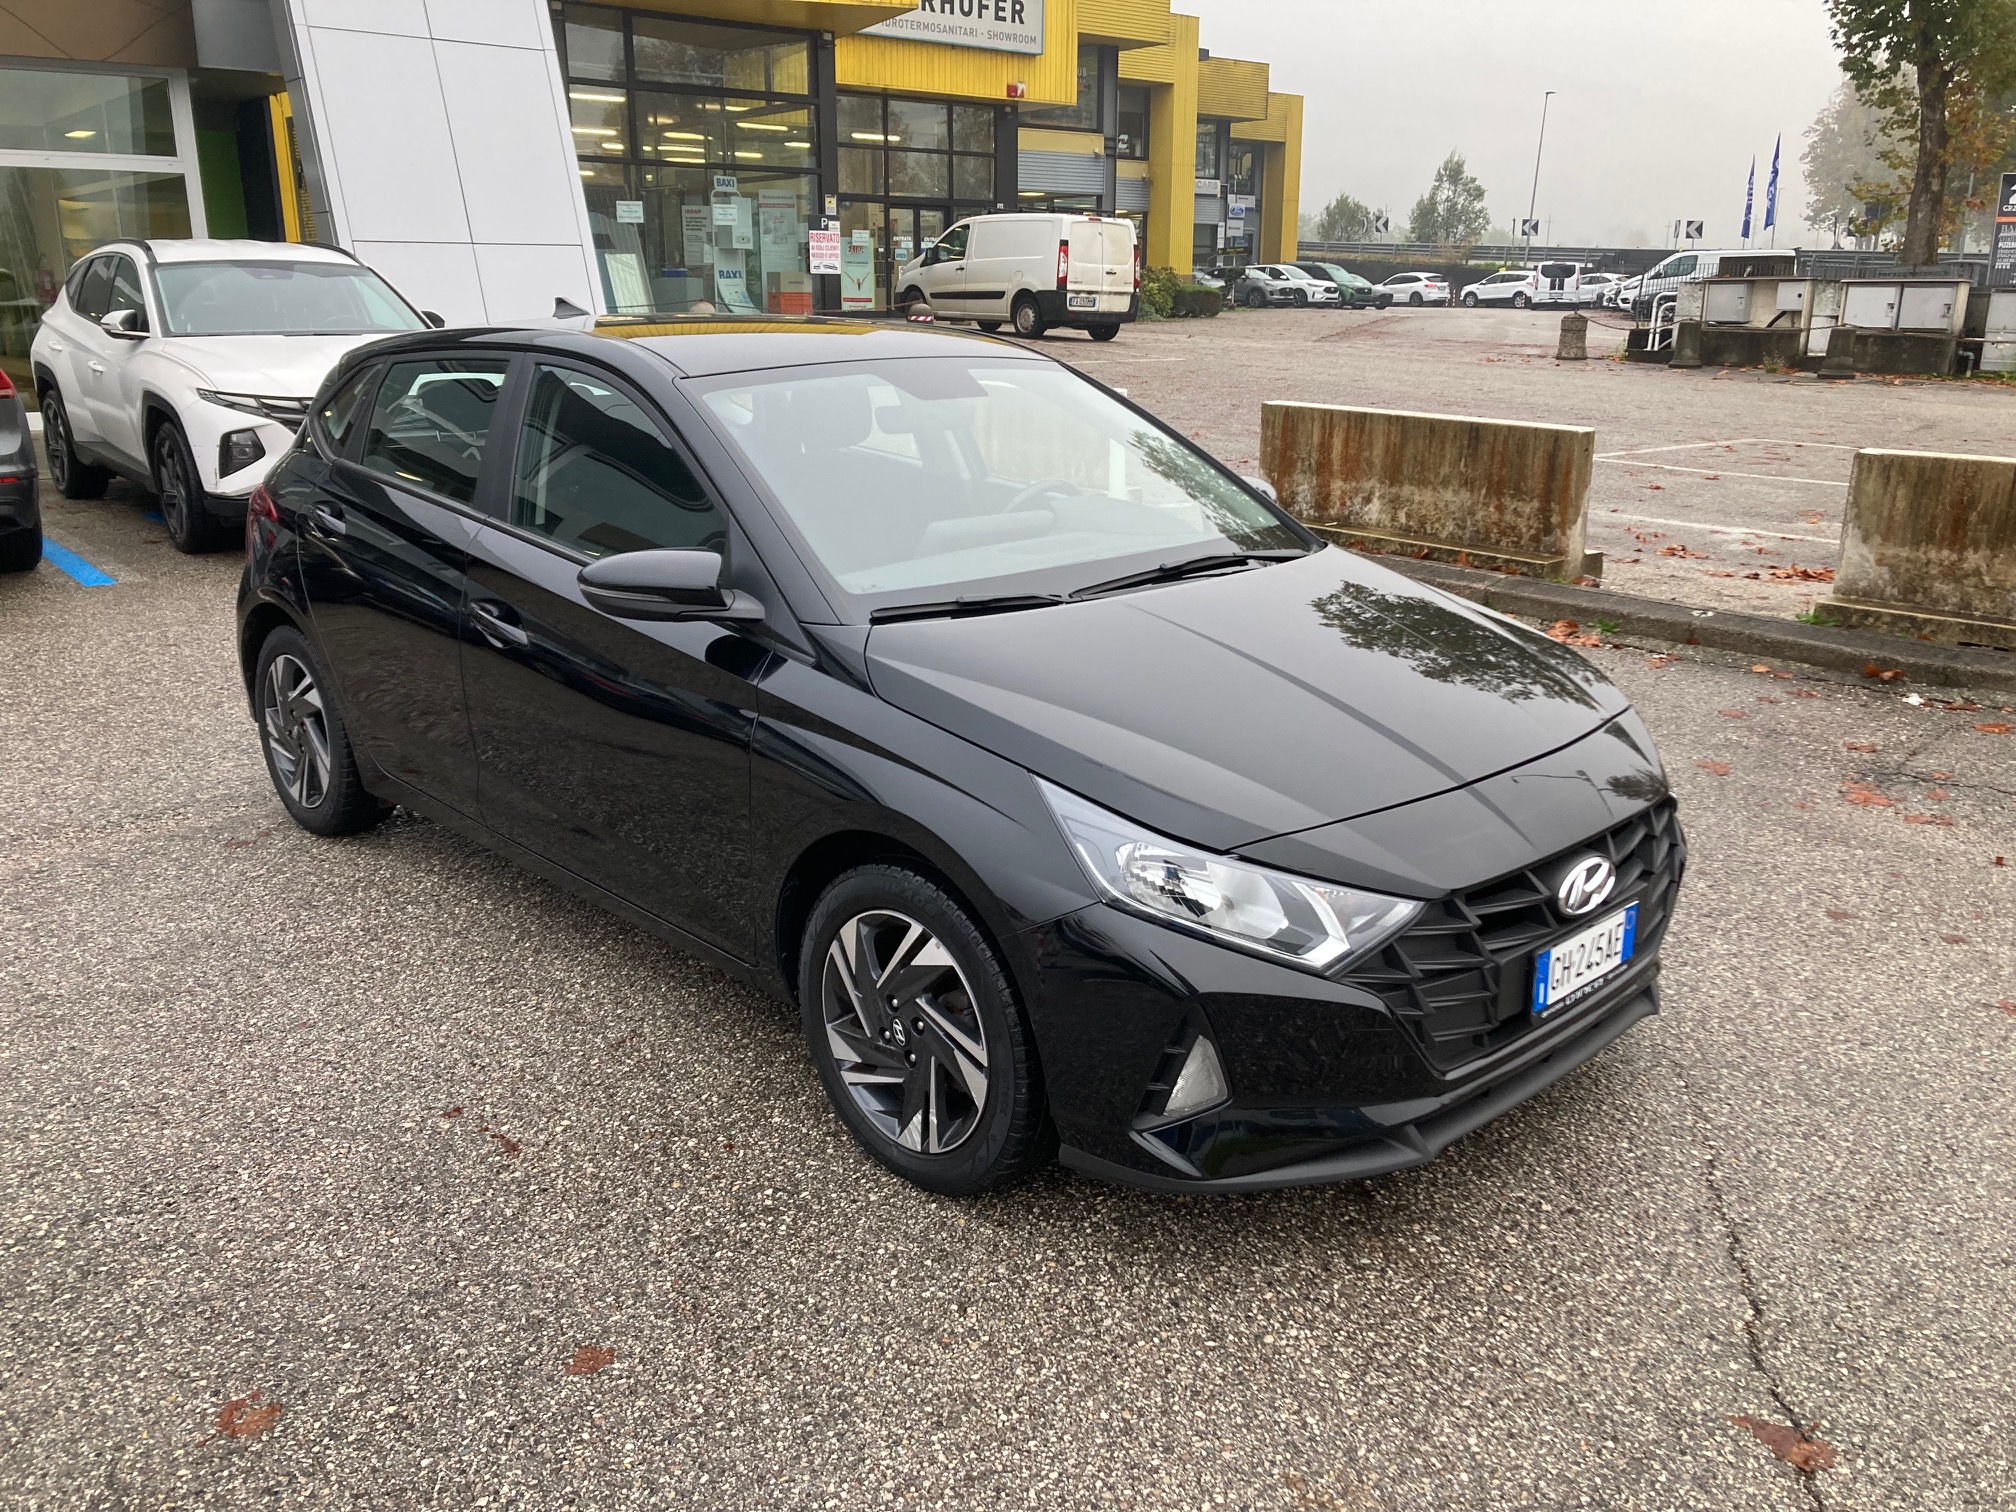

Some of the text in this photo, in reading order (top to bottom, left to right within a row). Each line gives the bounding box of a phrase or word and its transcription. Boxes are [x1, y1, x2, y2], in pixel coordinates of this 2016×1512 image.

[986, 30, 1037, 45] SHOWROOM
[716, 178, 735, 188] BAXI
[821, 217, 828, 229] P
[809, 232, 840, 244] RISERVATO
